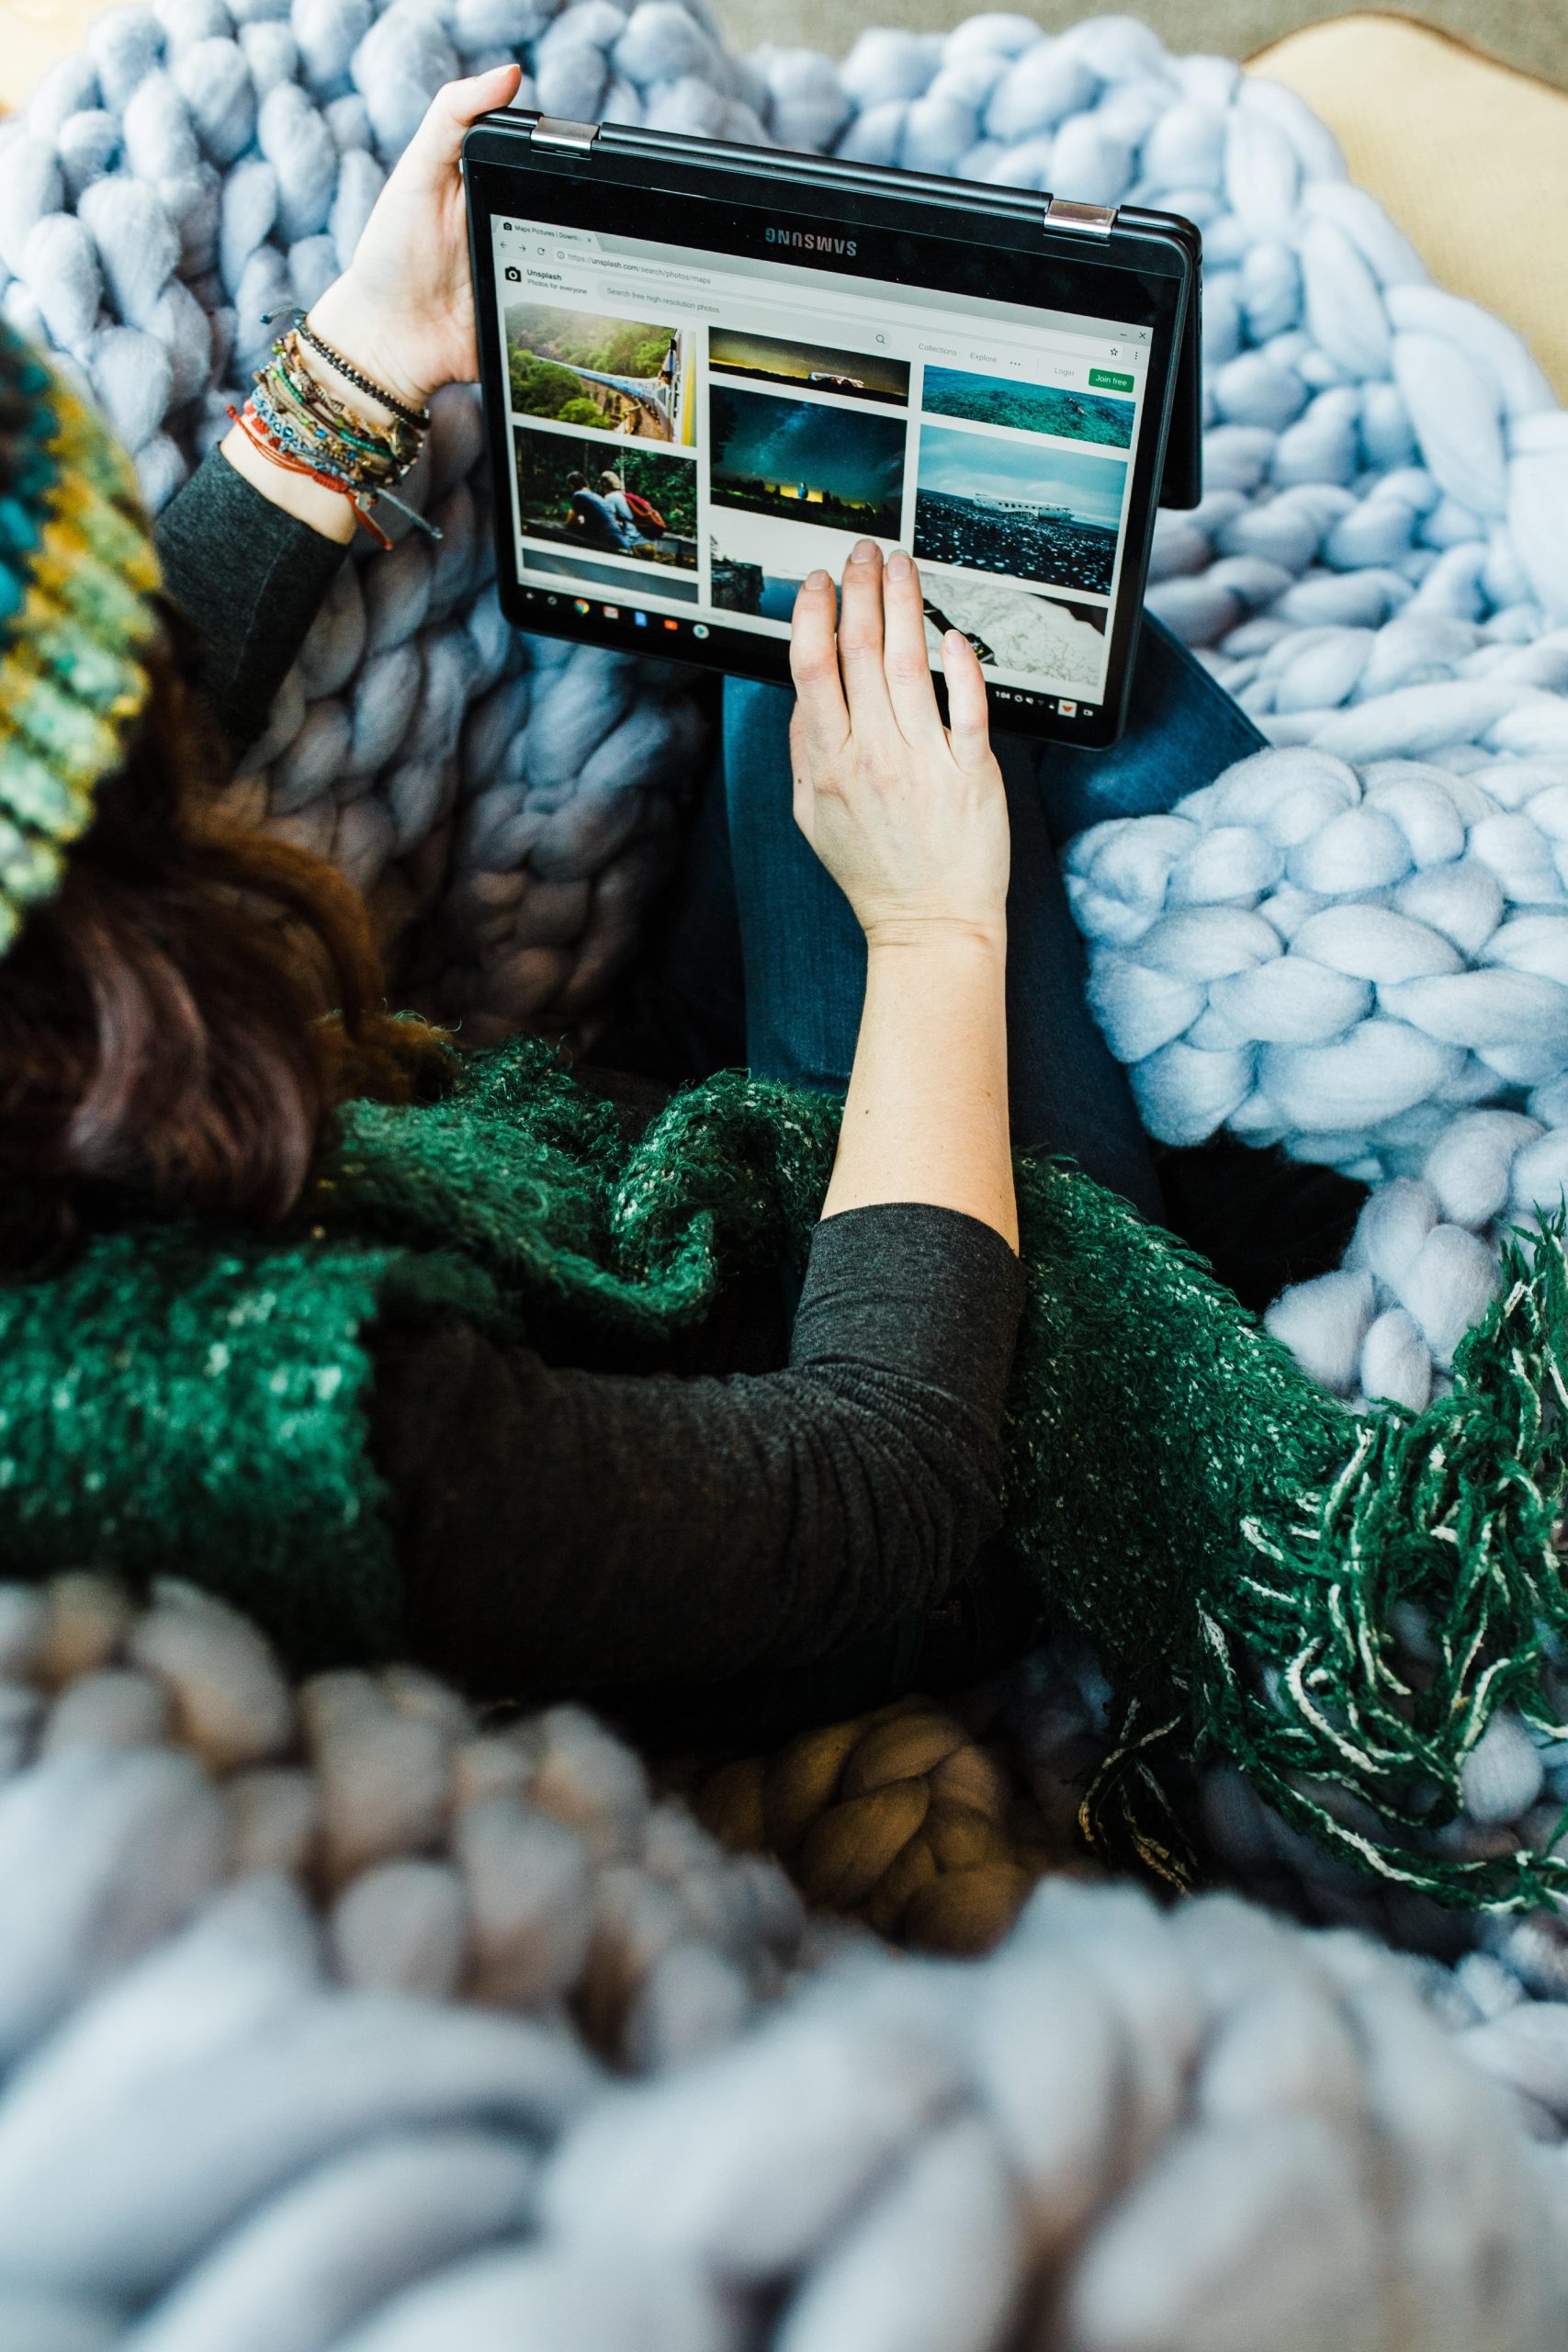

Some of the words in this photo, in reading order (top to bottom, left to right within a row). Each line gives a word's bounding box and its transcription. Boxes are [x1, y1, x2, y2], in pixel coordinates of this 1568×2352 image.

[514, 225, 530, 233] Maps
[531, 227, 555, 237] Pictures
[765, 227, 857, 256] SAMSUNG
[526, 268, 562, 281] Unsplash
[527, 278, 548, 288] Photos
[559, 285, 588, 295] everyone
[606, 287, 631, 299] Search
[631, 291, 645, 300] free
[646, 294, 696, 310] high-resolution
[696, 303, 720, 314] photos
[918, 343, 957, 356] Collections
[969, 352, 998, 364] Explore
[1054, 368, 1075, 378] Login
[1095, 374, 1111, 383] Join
[1112, 377, 1127, 387] free
